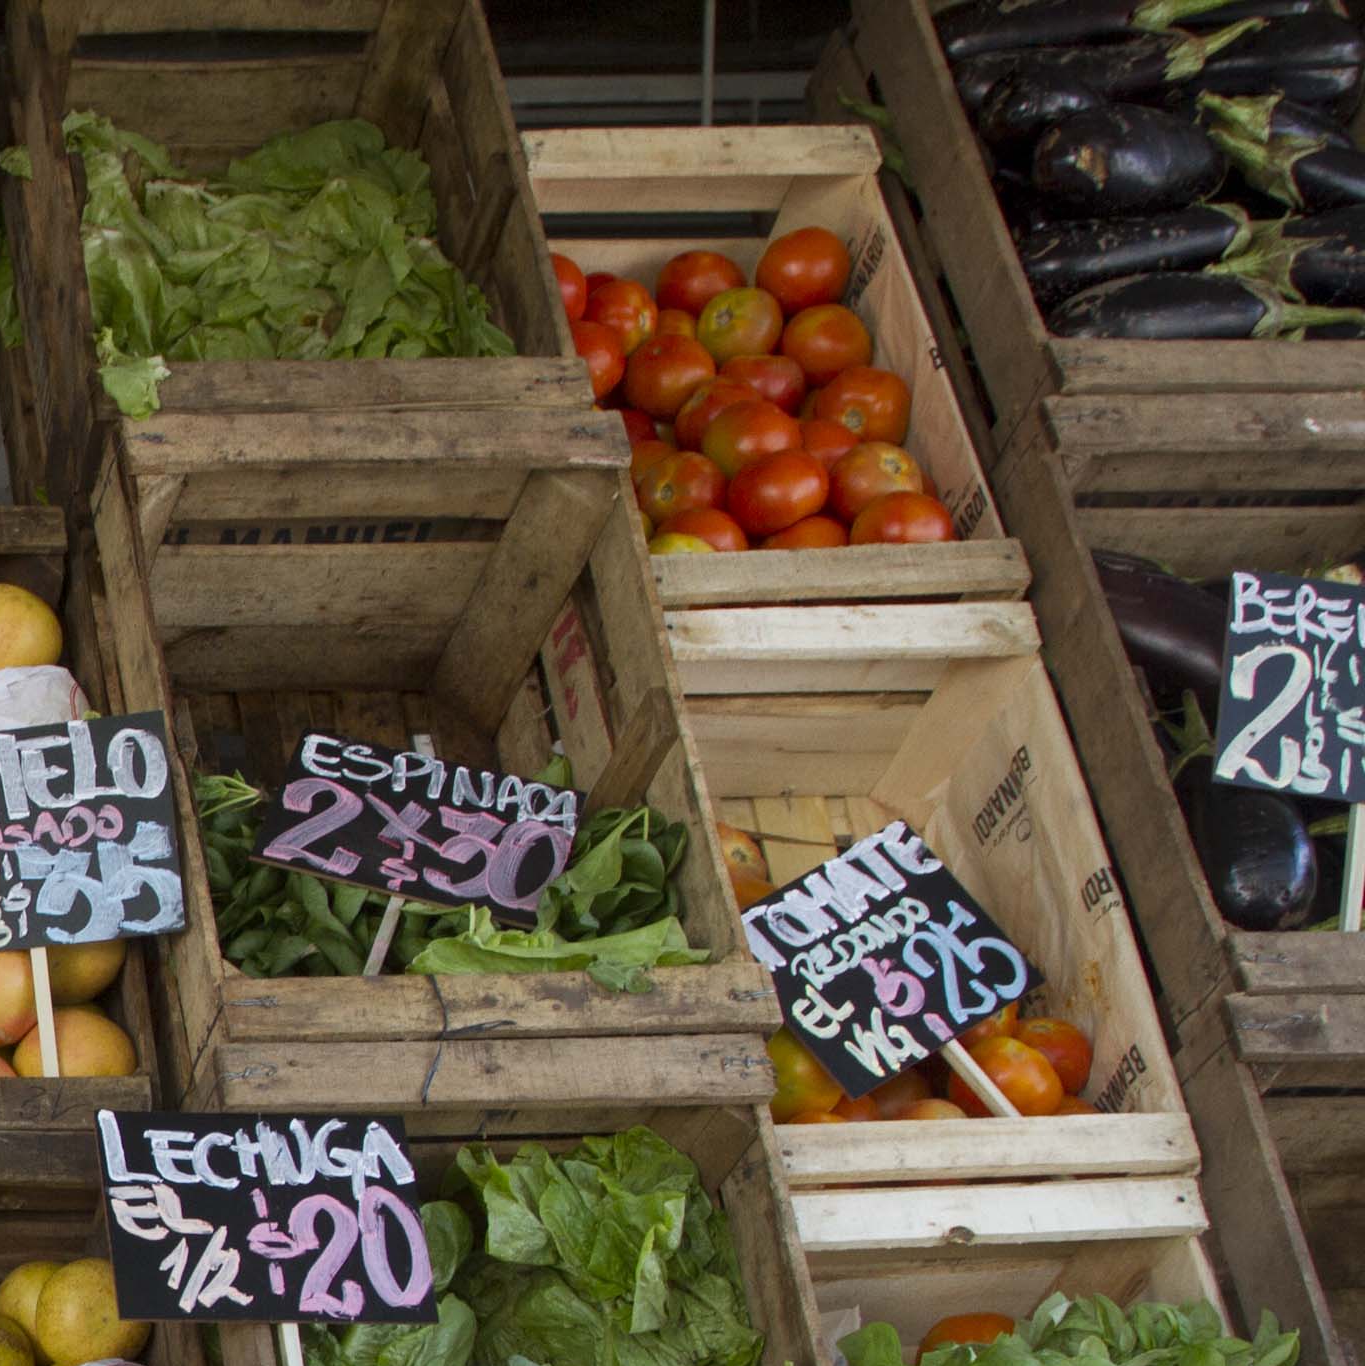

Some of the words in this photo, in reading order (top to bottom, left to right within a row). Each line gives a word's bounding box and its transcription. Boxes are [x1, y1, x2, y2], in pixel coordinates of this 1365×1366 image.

[1215, 640, 1312, 789] 2
[740, 819, 945, 972] TOMATE
[98, 1108, 415, 1200] LECHUGA
